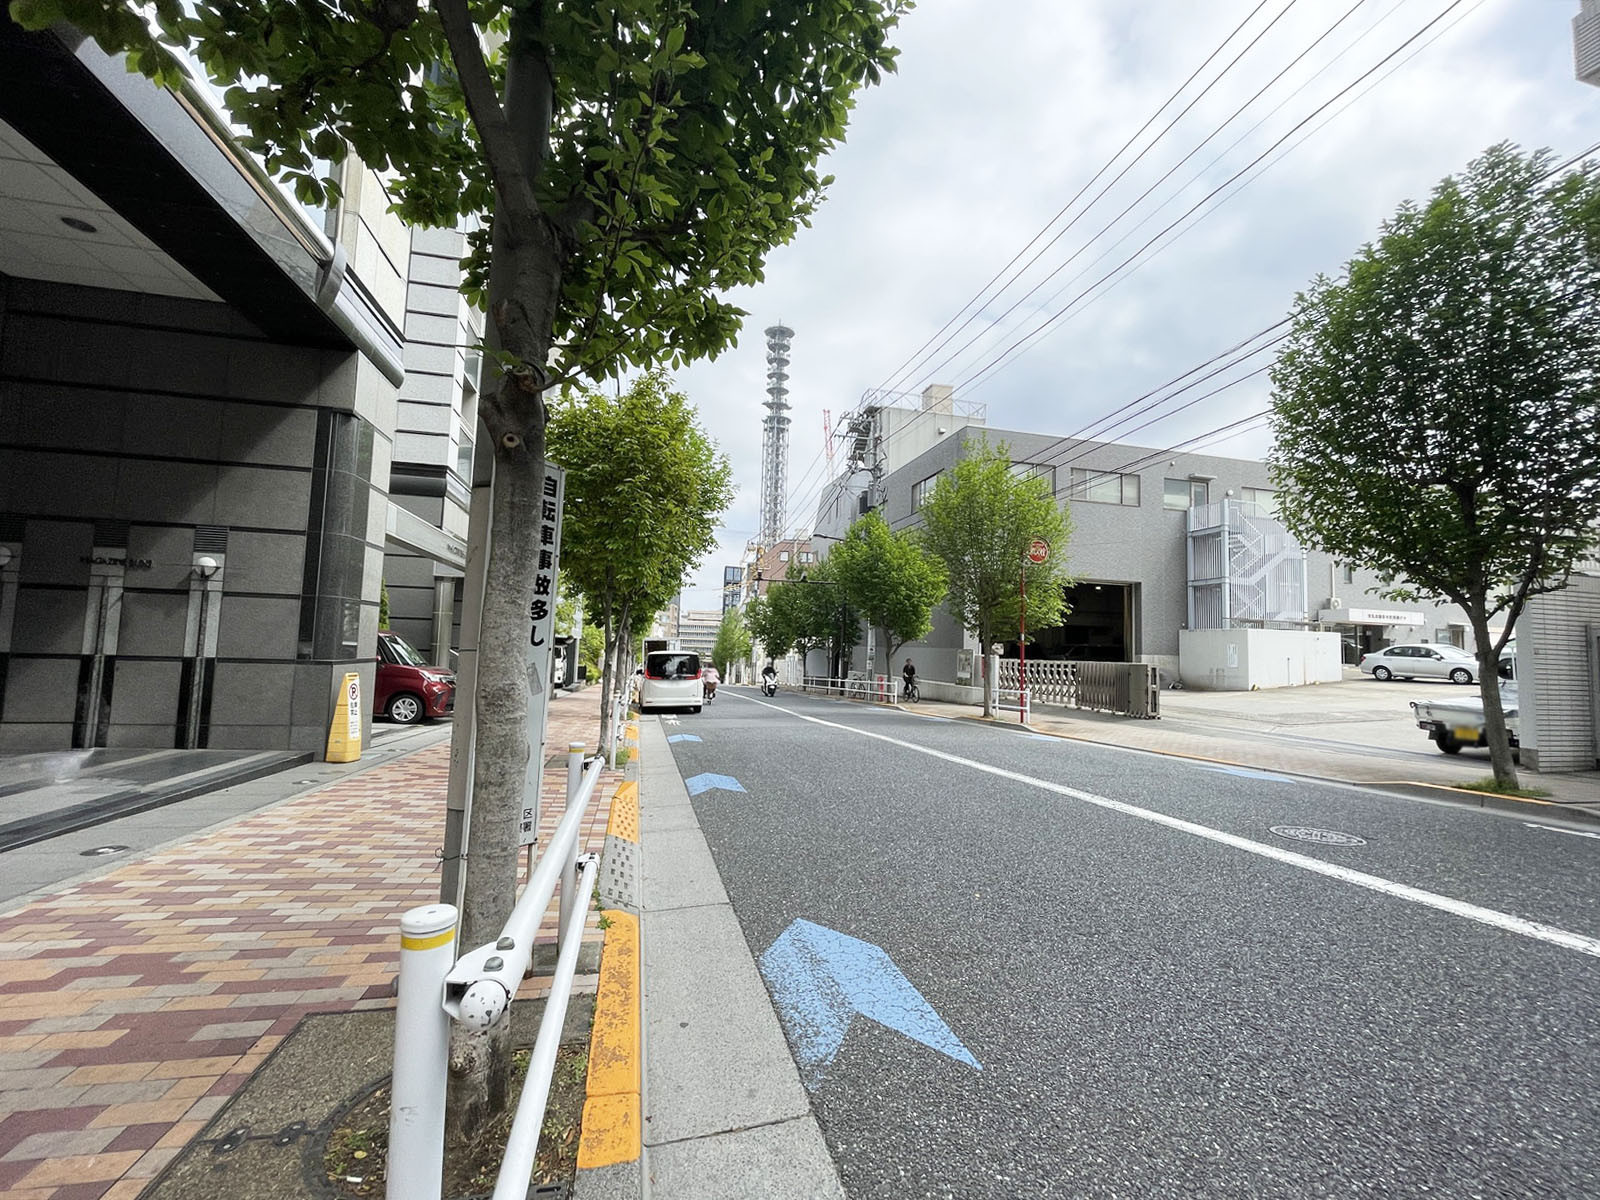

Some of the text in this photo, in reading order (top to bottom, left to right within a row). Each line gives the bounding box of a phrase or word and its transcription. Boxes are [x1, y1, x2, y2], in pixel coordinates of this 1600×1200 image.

[530, 476, 558, 646] 自転車事故多し
